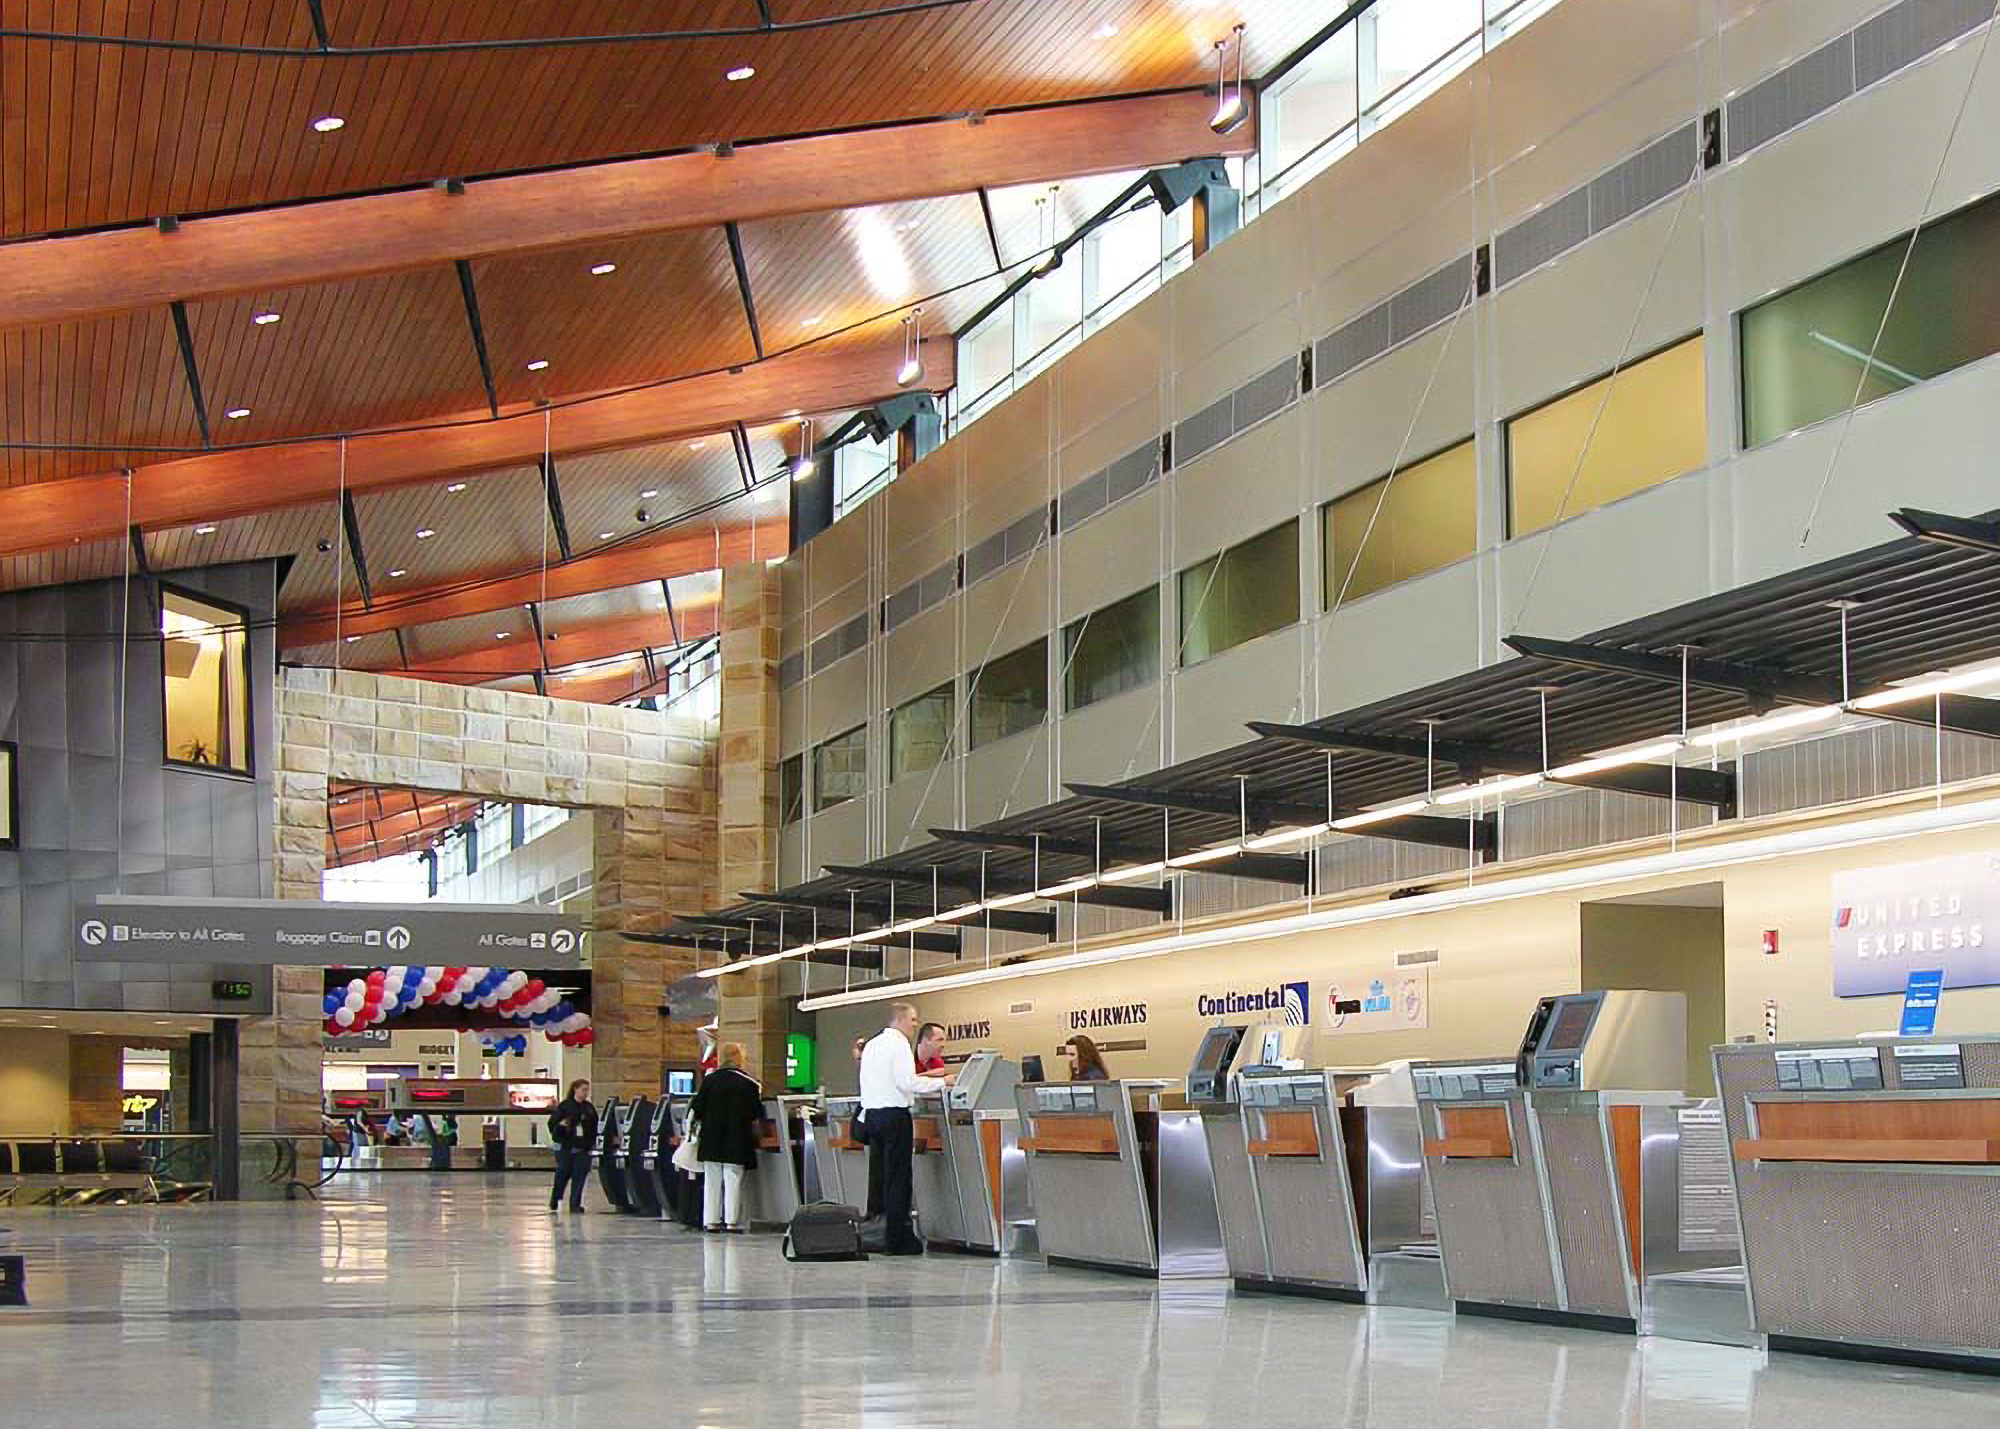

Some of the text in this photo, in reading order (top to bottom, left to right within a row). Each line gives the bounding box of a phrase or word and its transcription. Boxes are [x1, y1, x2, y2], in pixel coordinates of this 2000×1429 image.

[1856, 896, 1963, 925] UNITED
[178, 930, 191, 940] to
[192, 927, 209, 940] All
[275, 929, 363, 945] Baggage Claim
[480, 933, 493, 946] All
[1857, 924, 1984, 958] EXPRESS
[1198, 983, 1286, 1017] Continental
[1070, 1003, 1147, 1030] US AIRWAYS
